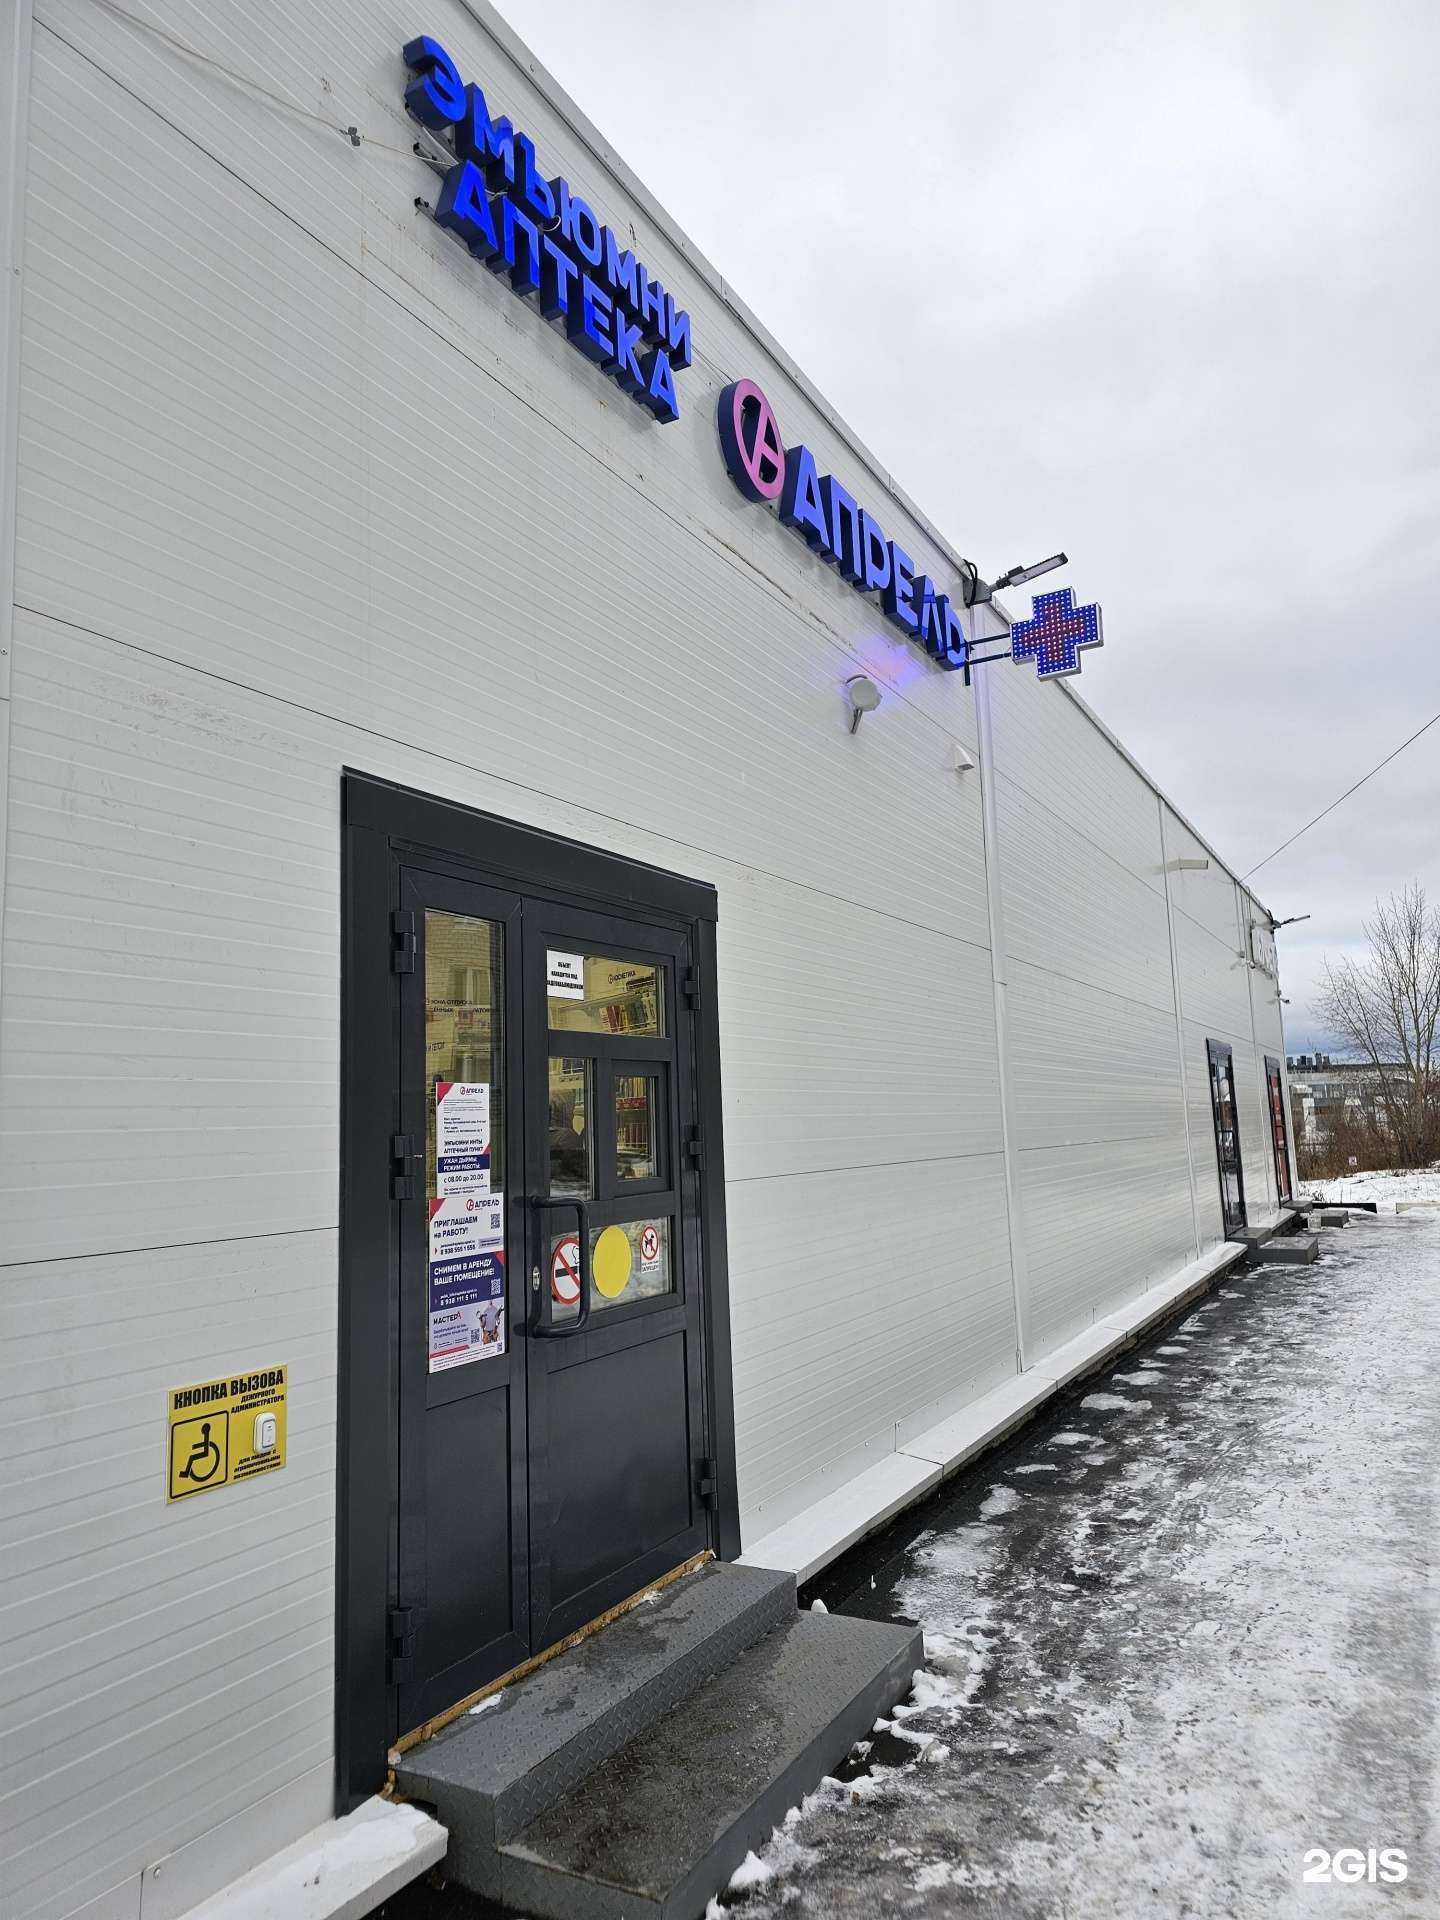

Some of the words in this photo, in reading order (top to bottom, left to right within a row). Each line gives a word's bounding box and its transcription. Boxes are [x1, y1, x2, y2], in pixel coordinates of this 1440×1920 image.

[434, 160, 680, 425] АПТЕКА
[779, 445, 967, 671] АПРЕЛЬ
[434, 1215, 479, 1228] ПРИГЛАШАЕМ
[434, 1263, 462, 1275] СНИМЕМ
[468, 1258, 492, 1268] АРЕНДУ
[434, 1275, 453, 1285] ВАШЕ
[454, 1268, 495, 1281] ПОМЕЩЕНИЕ!
[174, 1382, 228, 1410] КНОПКА
[230, 1369, 284, 1396] ВЫЗОВА
[231, 1394, 285, 1414] АДМИНИСТРАТОРА
